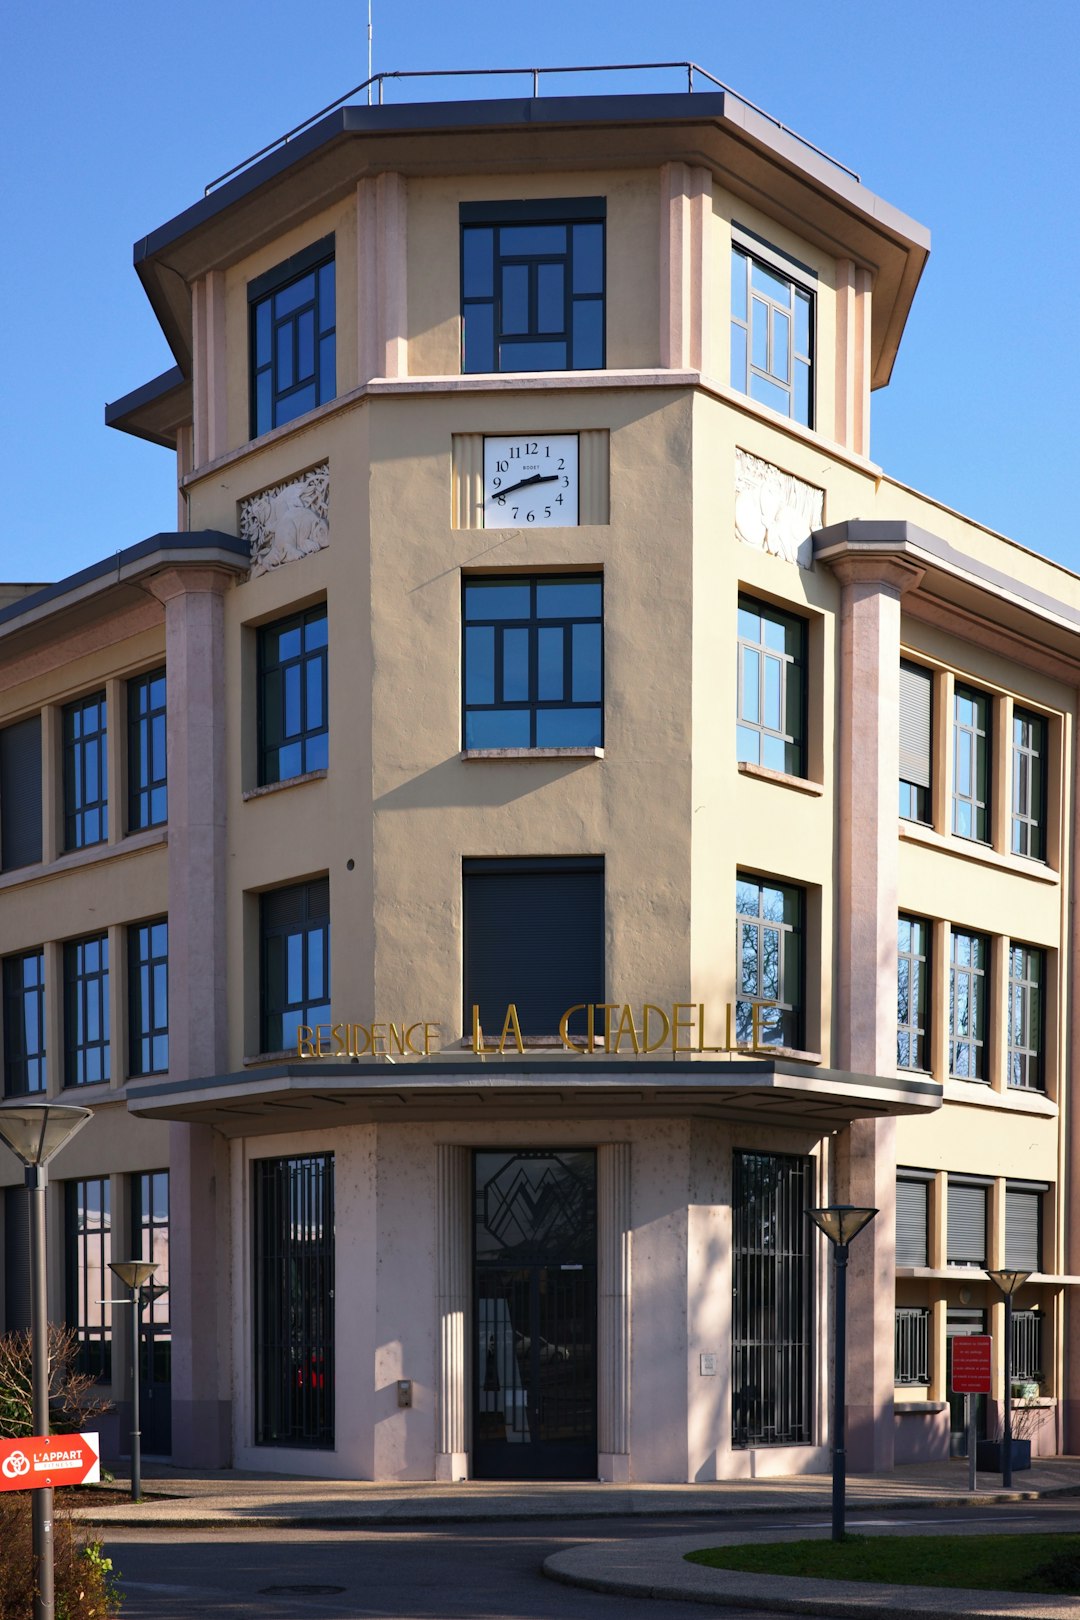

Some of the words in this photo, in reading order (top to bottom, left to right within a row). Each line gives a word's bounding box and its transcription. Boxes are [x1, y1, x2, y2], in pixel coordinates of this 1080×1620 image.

[509, 447, 520, 459] 11
[525, 443, 539, 455] 12
[545, 446, 550, 458] 1
[496, 460, 509, 472] 10
[557, 458, 565, 470] 2
[493, 477, 502, 489] 9
[561, 475, 569, 487] 3
[497, 494, 506, 506] 8
[555, 493, 563, 505] 4
[511, 507, 519, 519] 7
[526, 510, 535, 522] 6
[544, 506, 552, 518] 5
[297, 1022, 441, 1057] RESIDENCE
[472, 1003, 524, 1055] LA
[559, 1002, 776, 1054] CITADELLE
[33, 1450, 82, 1462] L'APPART
